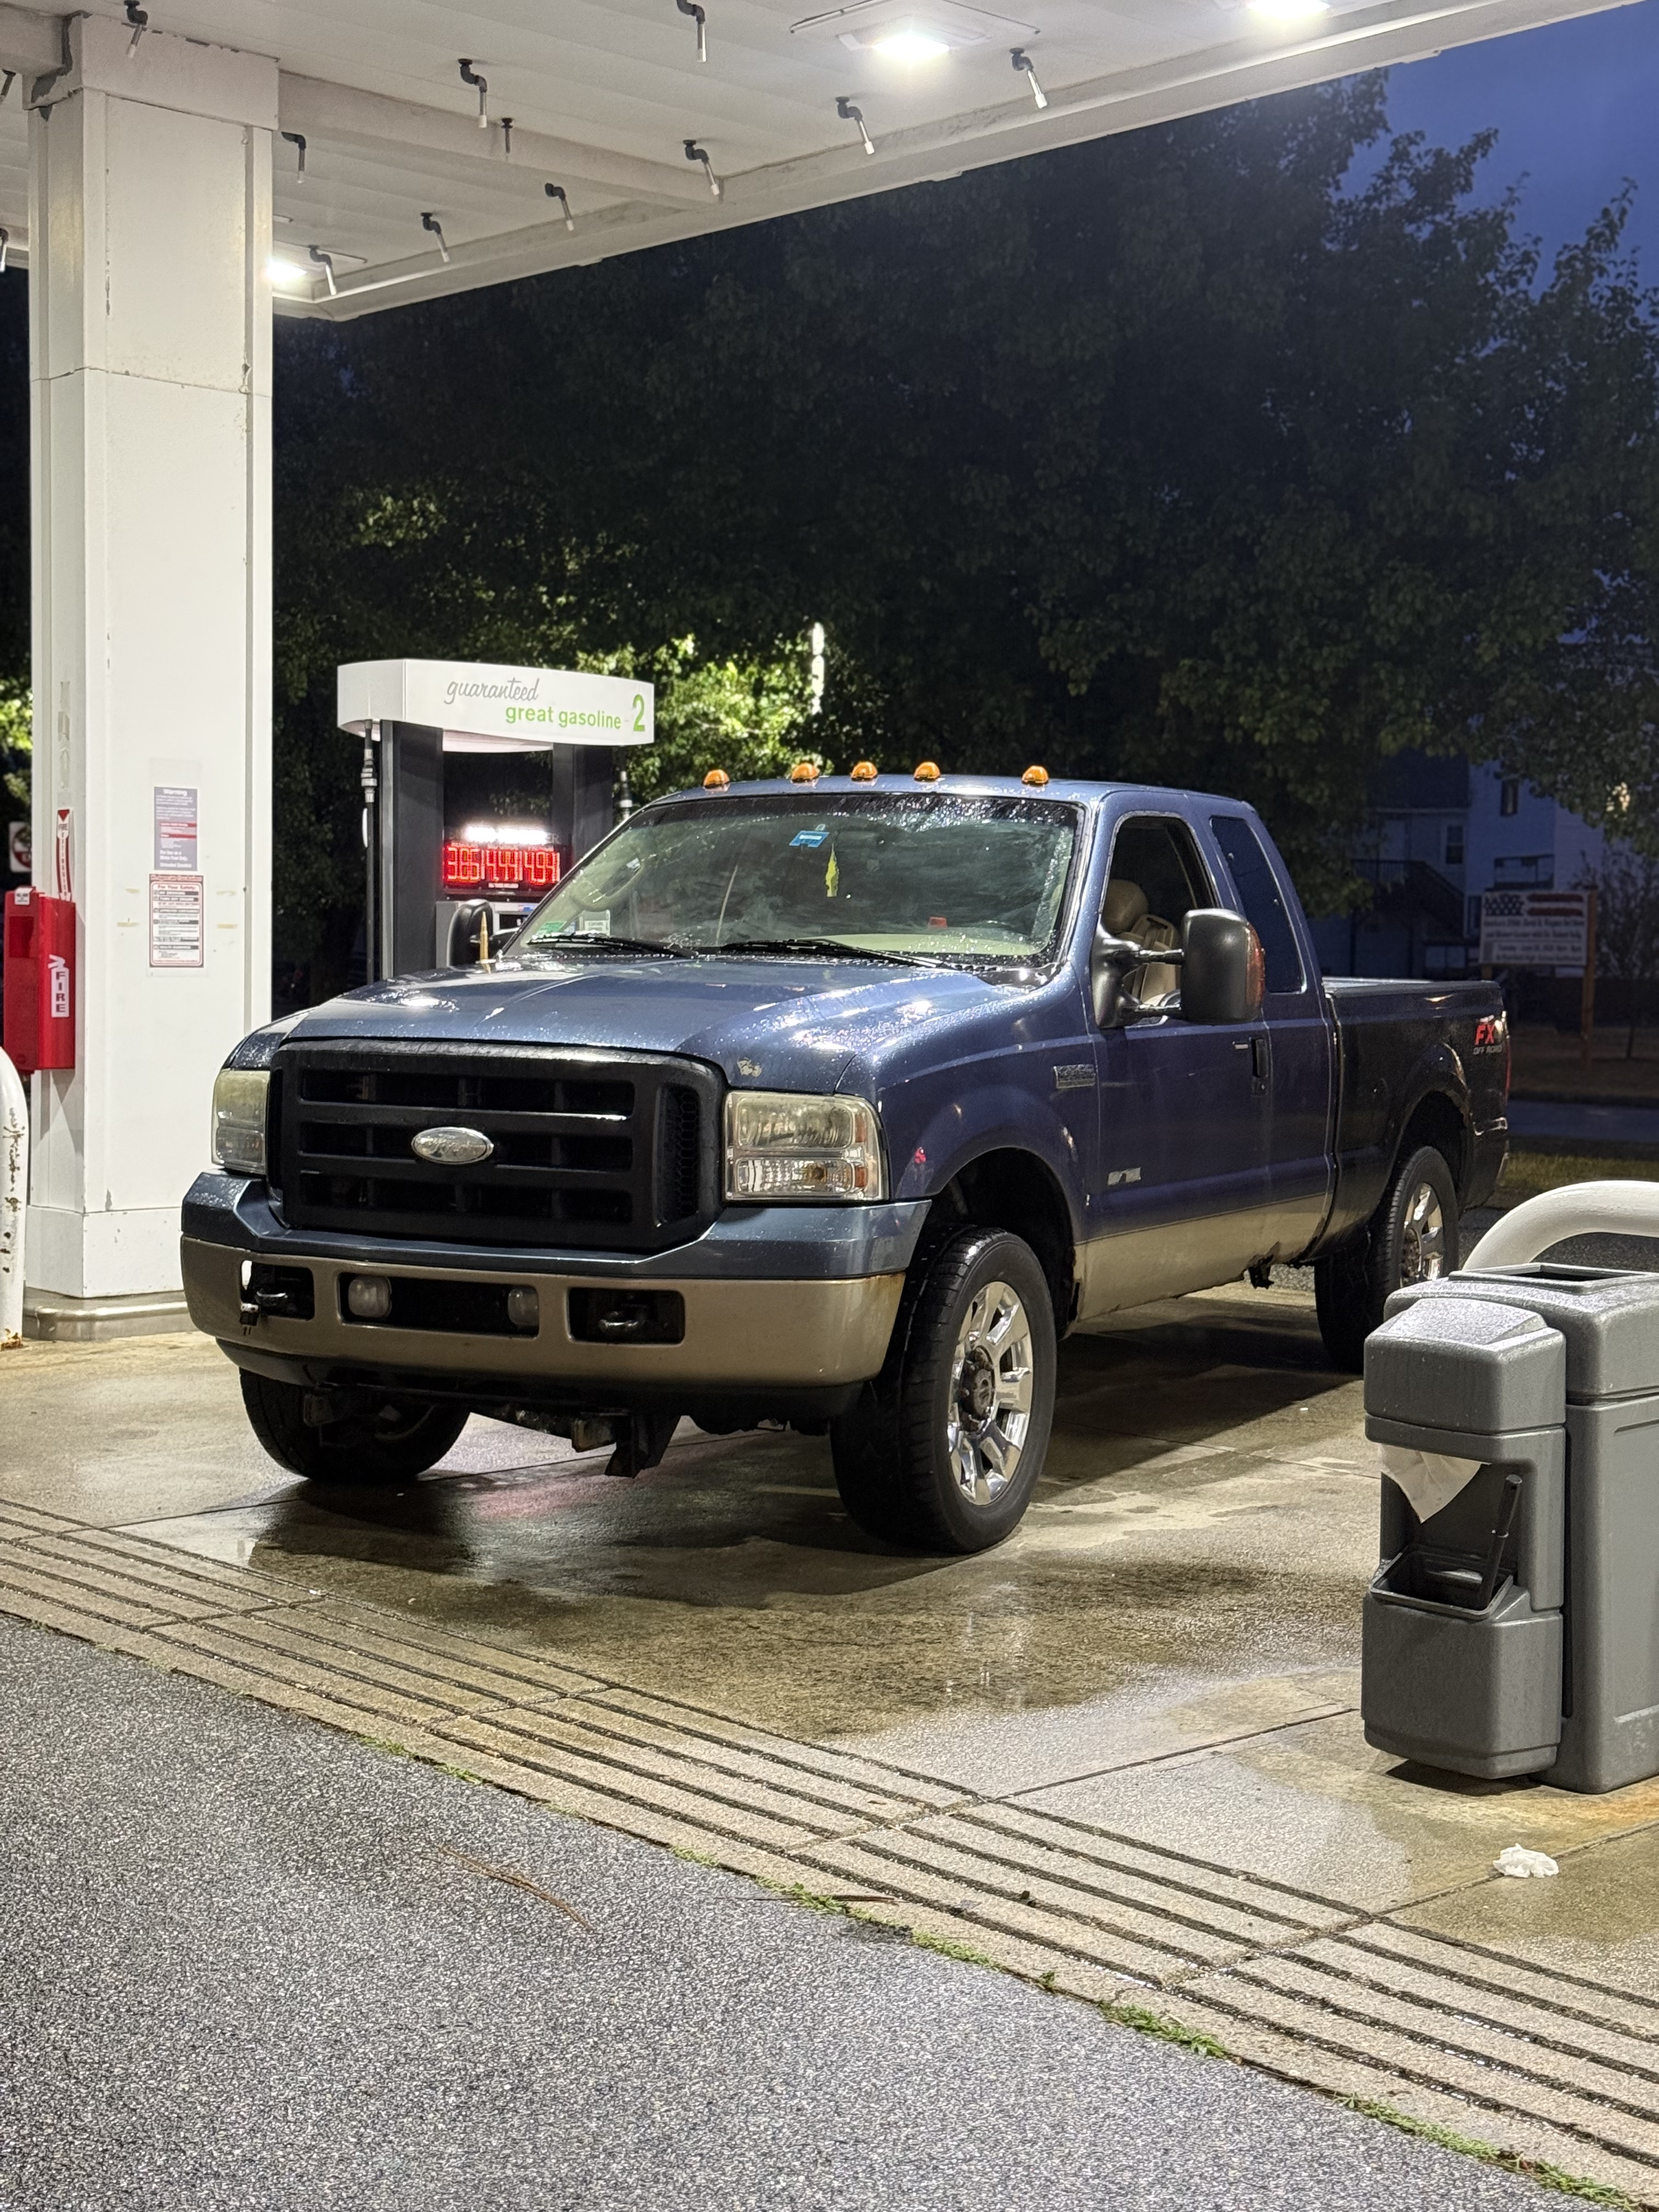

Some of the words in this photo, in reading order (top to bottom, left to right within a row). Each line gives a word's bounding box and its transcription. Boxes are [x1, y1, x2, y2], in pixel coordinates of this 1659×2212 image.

[444, 677, 540, 705] guaranteed
[506, 707, 553, 724] great
[559, 710, 621, 729] gasoline
[633, 694, 645, 732] 2
[56, 972, 65, 1013] FIRE
